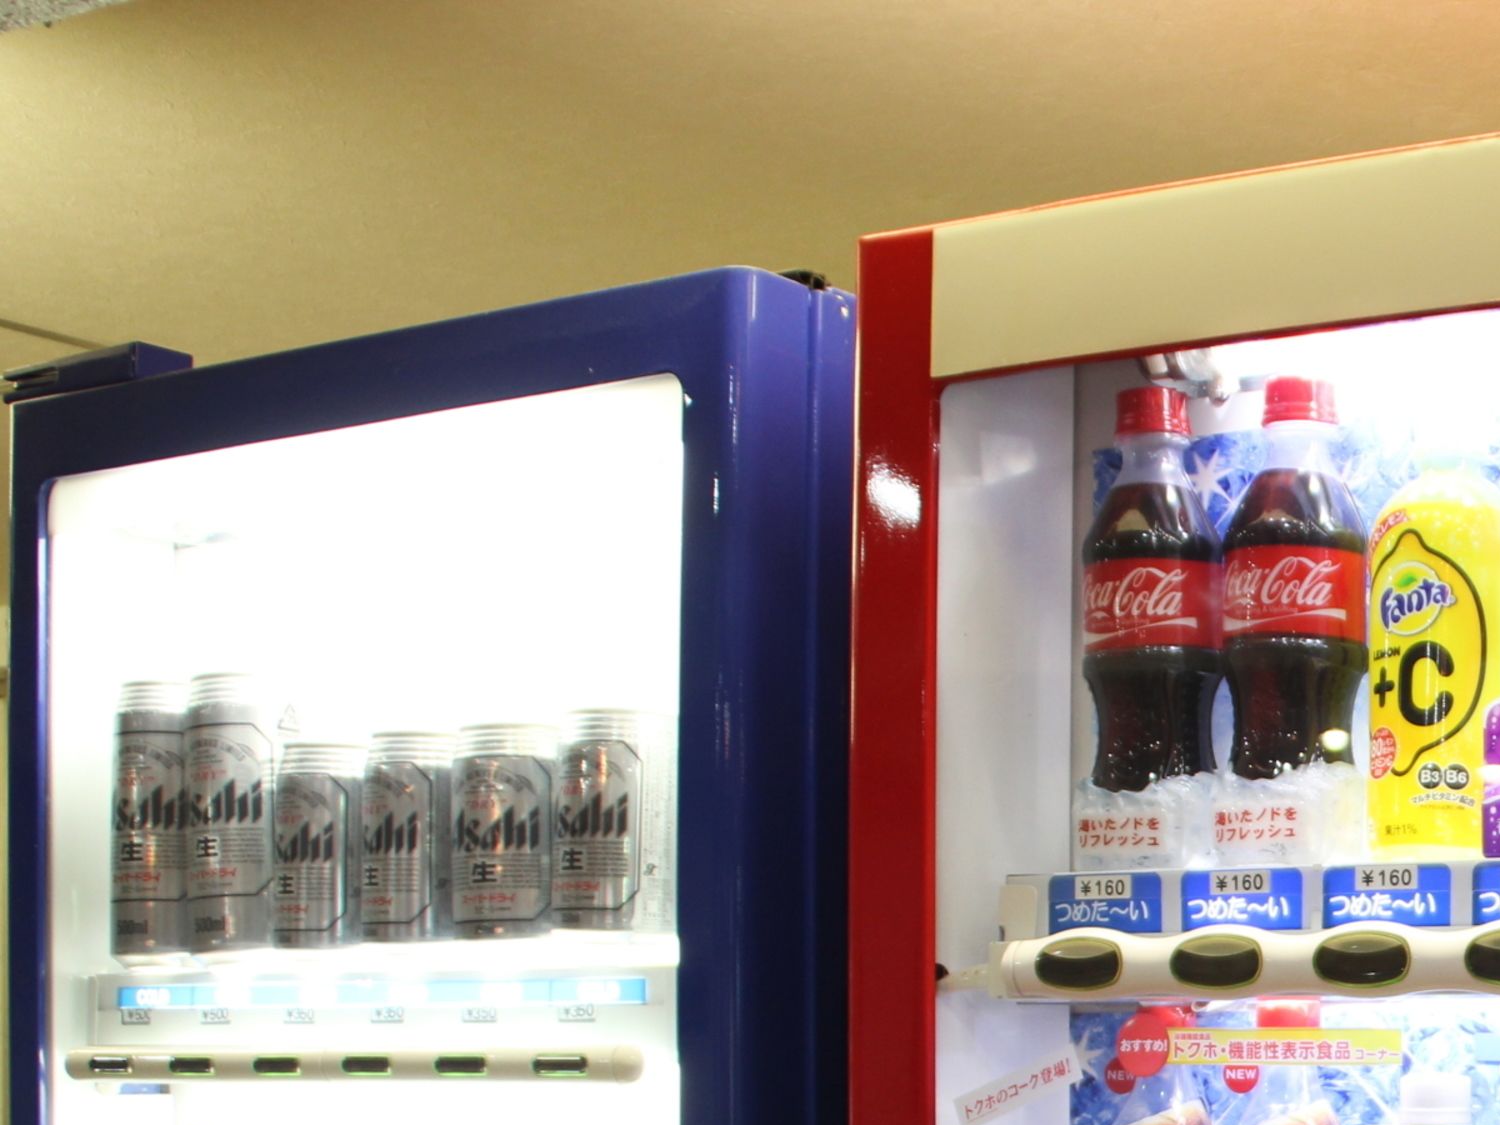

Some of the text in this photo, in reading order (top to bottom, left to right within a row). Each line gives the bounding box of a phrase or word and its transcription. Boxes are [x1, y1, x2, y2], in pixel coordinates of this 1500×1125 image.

[1380, 577, 1449, 630] Fanta
[1373, 646, 1401, 662] LEMON
[1214, 806, 1297, 826] 渇いたノドを
[1079, 832, 1160, 849] リフレッシュ
[1215, 824, 1297, 843] リフレッシュ
[120, 840, 144, 862] 生
[196, 836, 219, 858] 生
[561, 847, 584, 871] 生
[471, 860, 498, 884] 生
[1362, 867, 1413, 888] ¥160
[1080, 877, 1125, 898] ¥160
[1216, 873, 1264, 893] ¥160
[1120, 1038, 1168, 1052] おすすめ!
[1172, 1040, 1400, 1061] トクホ・機能性表示食品 コーナー
[1225, 1067, 1257, 1081] NEW
[961, 1057, 1072, 1121] トクホのコーク登場!
